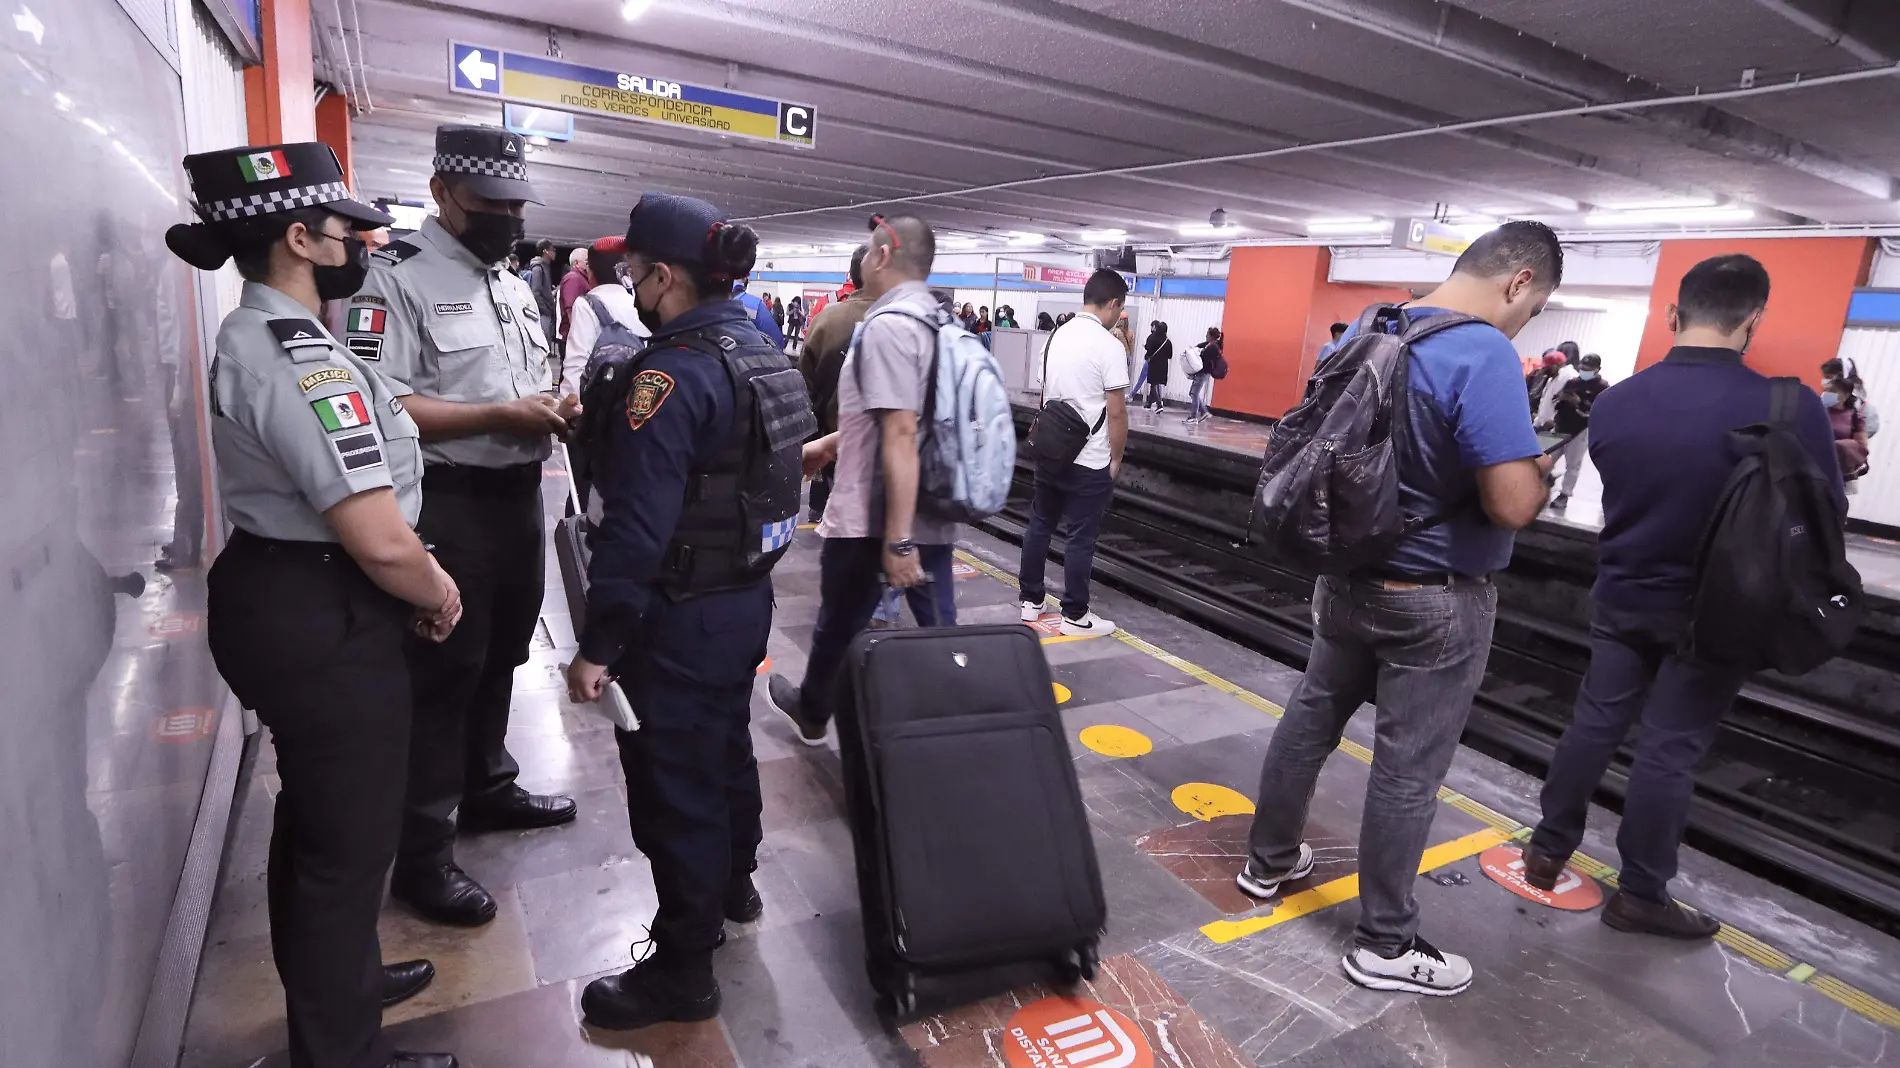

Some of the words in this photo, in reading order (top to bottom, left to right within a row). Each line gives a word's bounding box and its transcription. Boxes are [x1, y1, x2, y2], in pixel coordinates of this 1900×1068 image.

[582, 85, 712, 117] CORRESPONDENCIA
[617, 73, 681, 99] SALIDA
[560, 94, 598, 109] INDIOS
[603, 102, 649, 117] VERDES
[661, 111, 731, 130] UNIVERSIDAD
[786, 106, 808, 136] C
[1411, 222, 1425, 242] C
[303, 370, 350, 388] MEXICO
[1485, 864, 1552, 904] DISTANCIA
[1036, 1037, 1069, 1068] SAN
